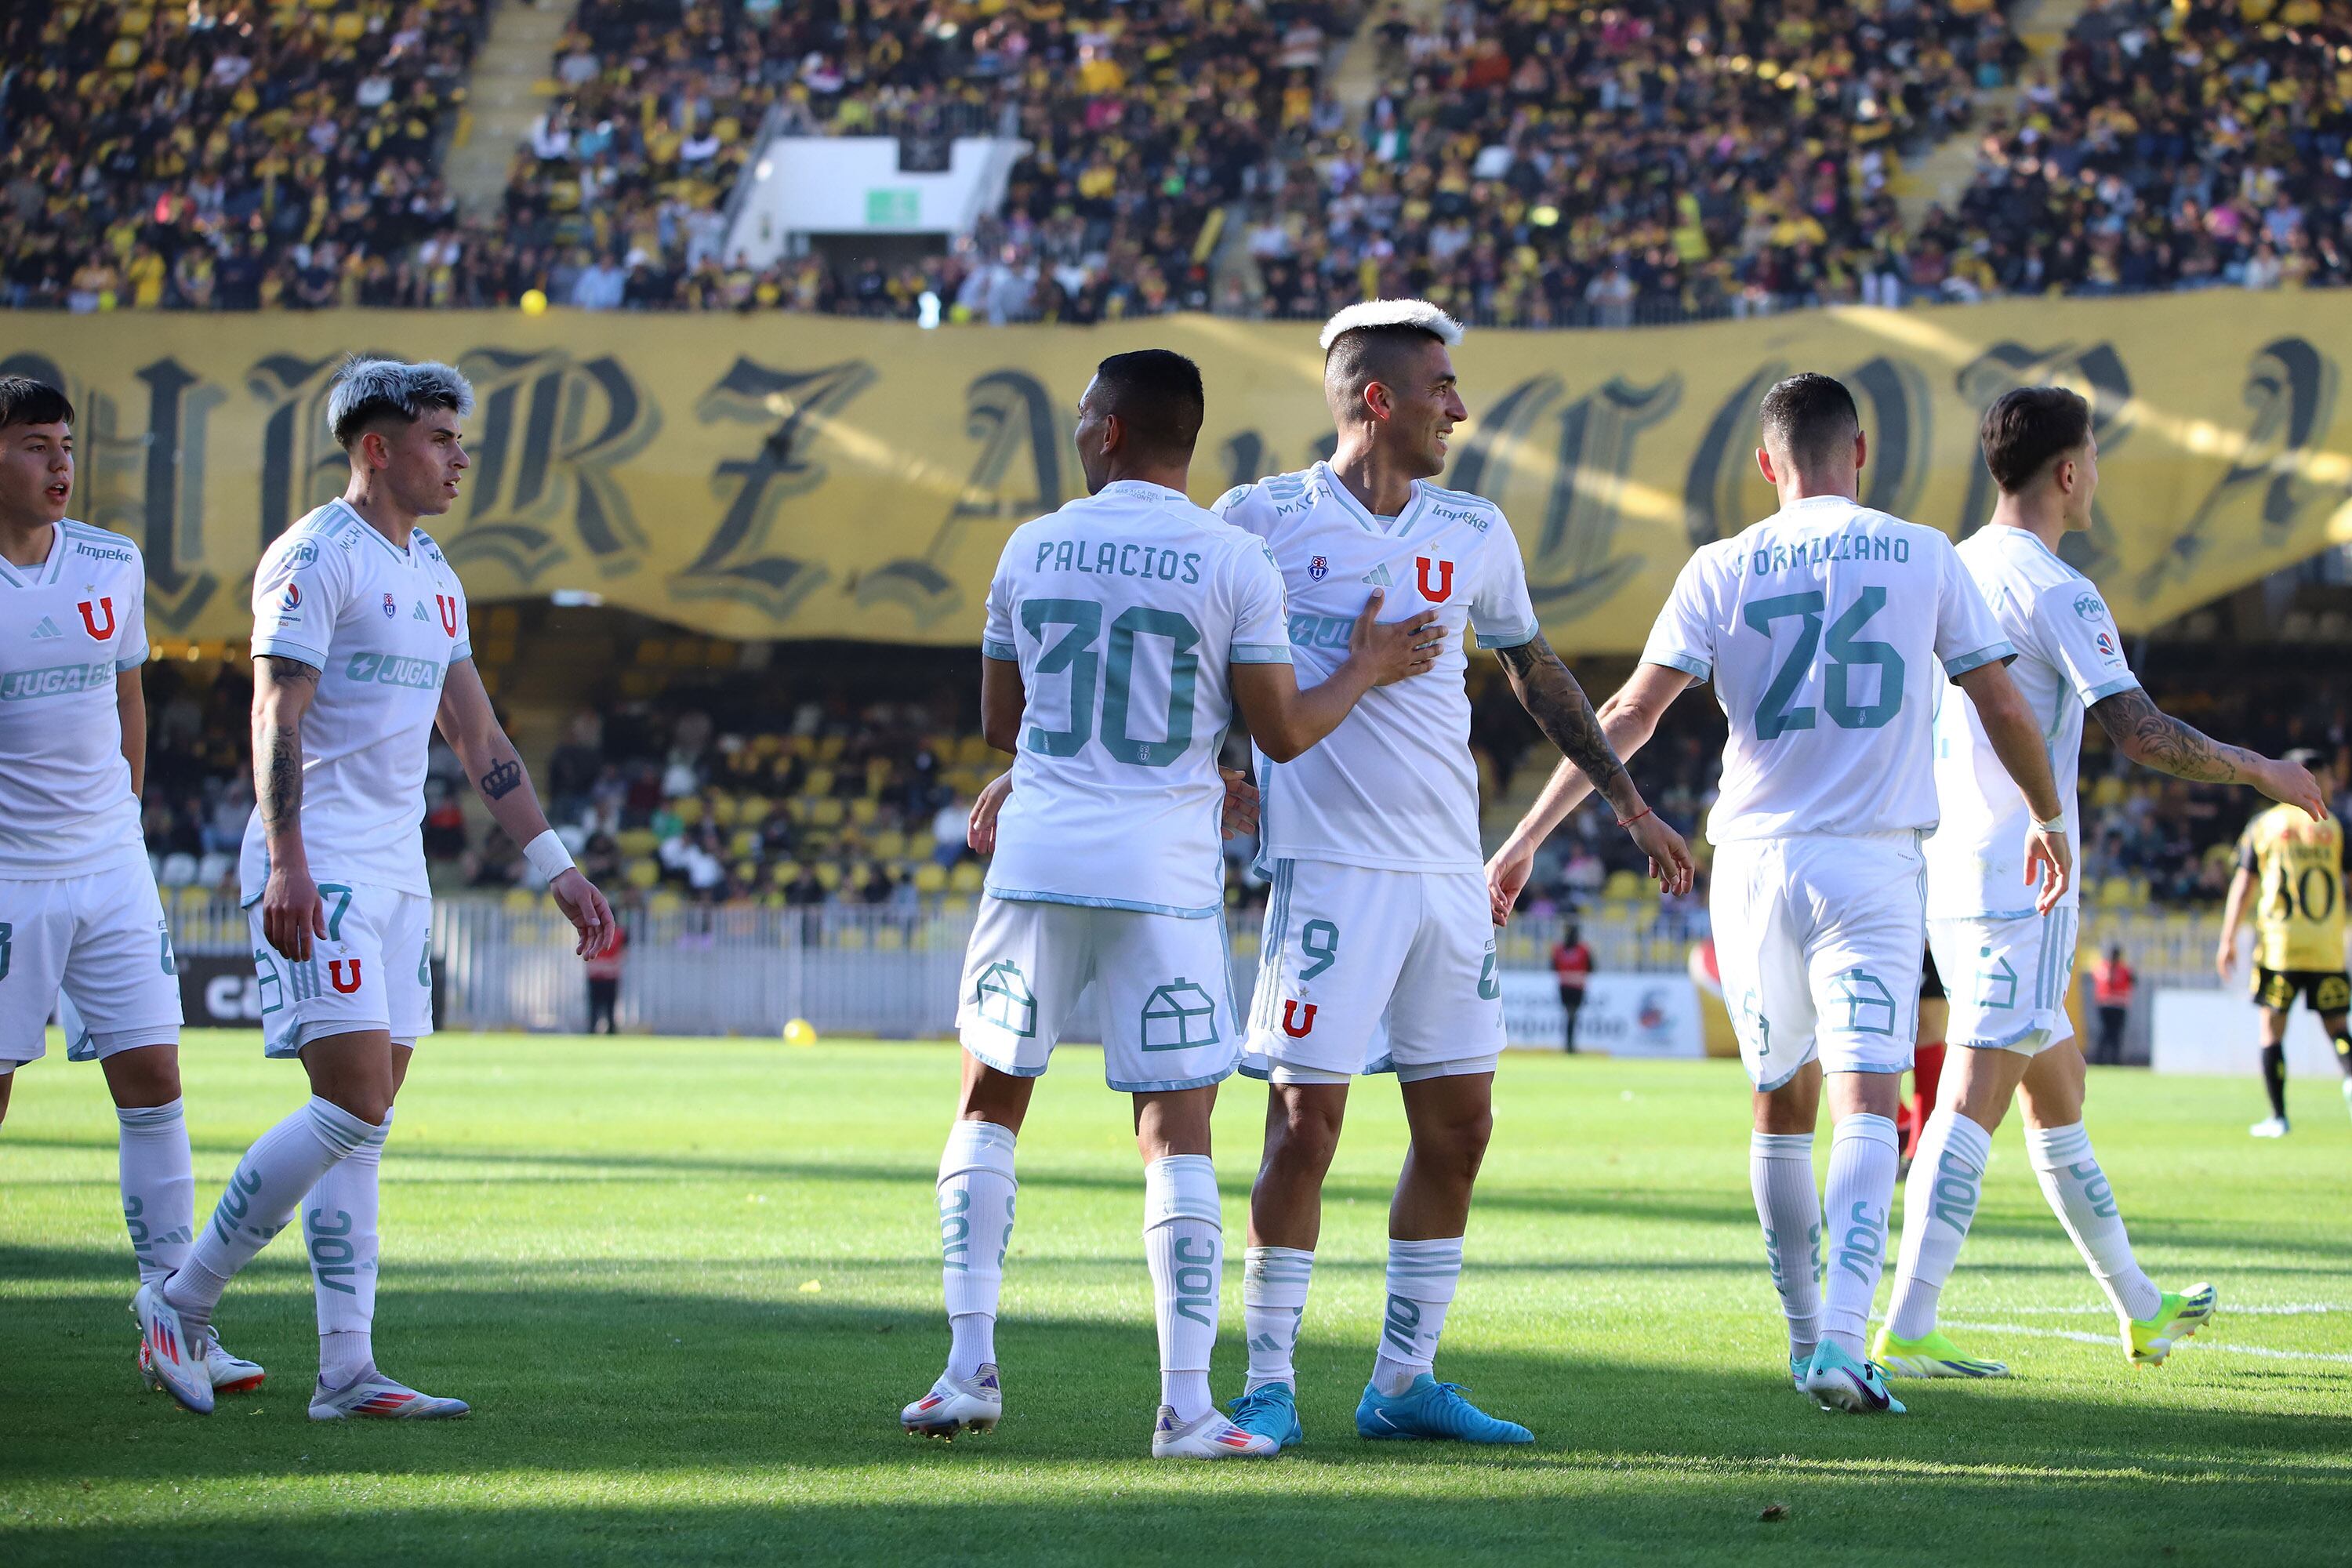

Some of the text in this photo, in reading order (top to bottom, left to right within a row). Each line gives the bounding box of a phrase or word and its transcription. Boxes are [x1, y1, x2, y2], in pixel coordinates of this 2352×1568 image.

[1432, 503, 1489, 532] Impeke
[76, 542, 133, 564] Impeke
[1035, 540, 1202, 585] PALACIOS
[1416, 556, 1454, 604] U
[78, 597, 116, 641] U
[436, 594, 457, 638] U
[1021, 598, 1201, 767] 30
[1744, 586, 1905, 741] 26
[317, 883, 353, 942] 7
[1300, 919, 1339, 981] 9
[329, 959, 361, 993] U
[1283, 1000, 1318, 1038] U
